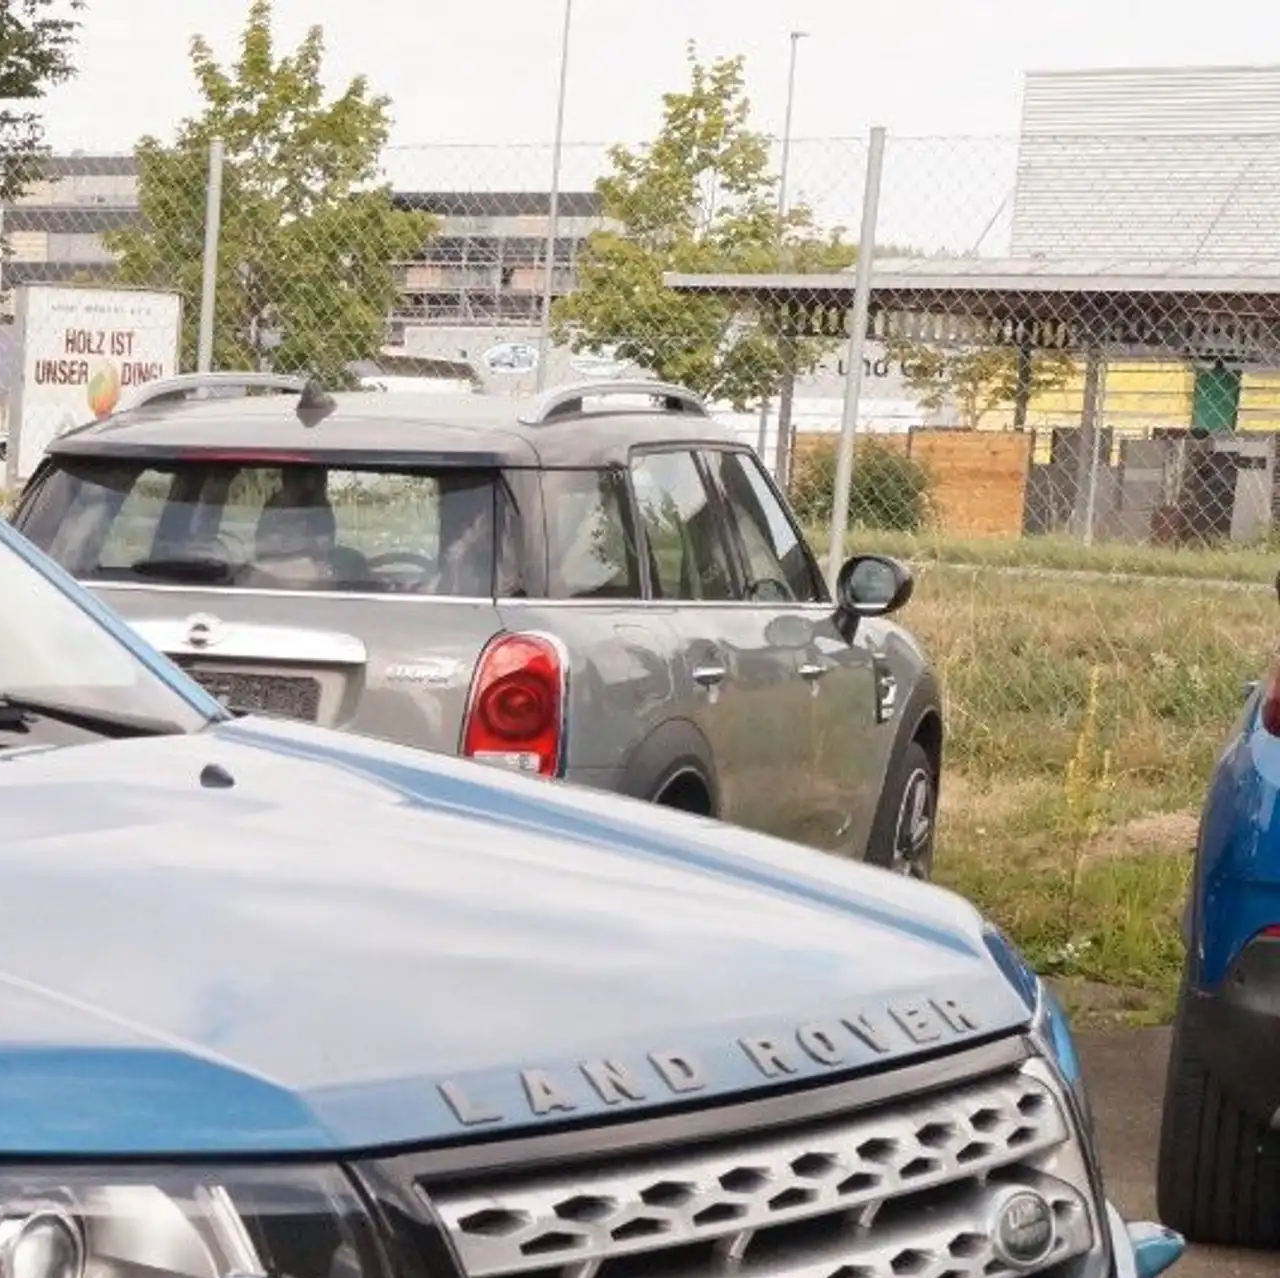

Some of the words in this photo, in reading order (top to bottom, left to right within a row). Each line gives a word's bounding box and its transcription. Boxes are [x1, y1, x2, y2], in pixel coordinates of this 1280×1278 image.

[64, 328, 105, 355] HOLZ
[111, 331, 135, 356] IST
[35, 359, 89, 386] UNSER
[436, 1047, 706, 1126] LAND
[739, 998, 977, 1078] ROVER
